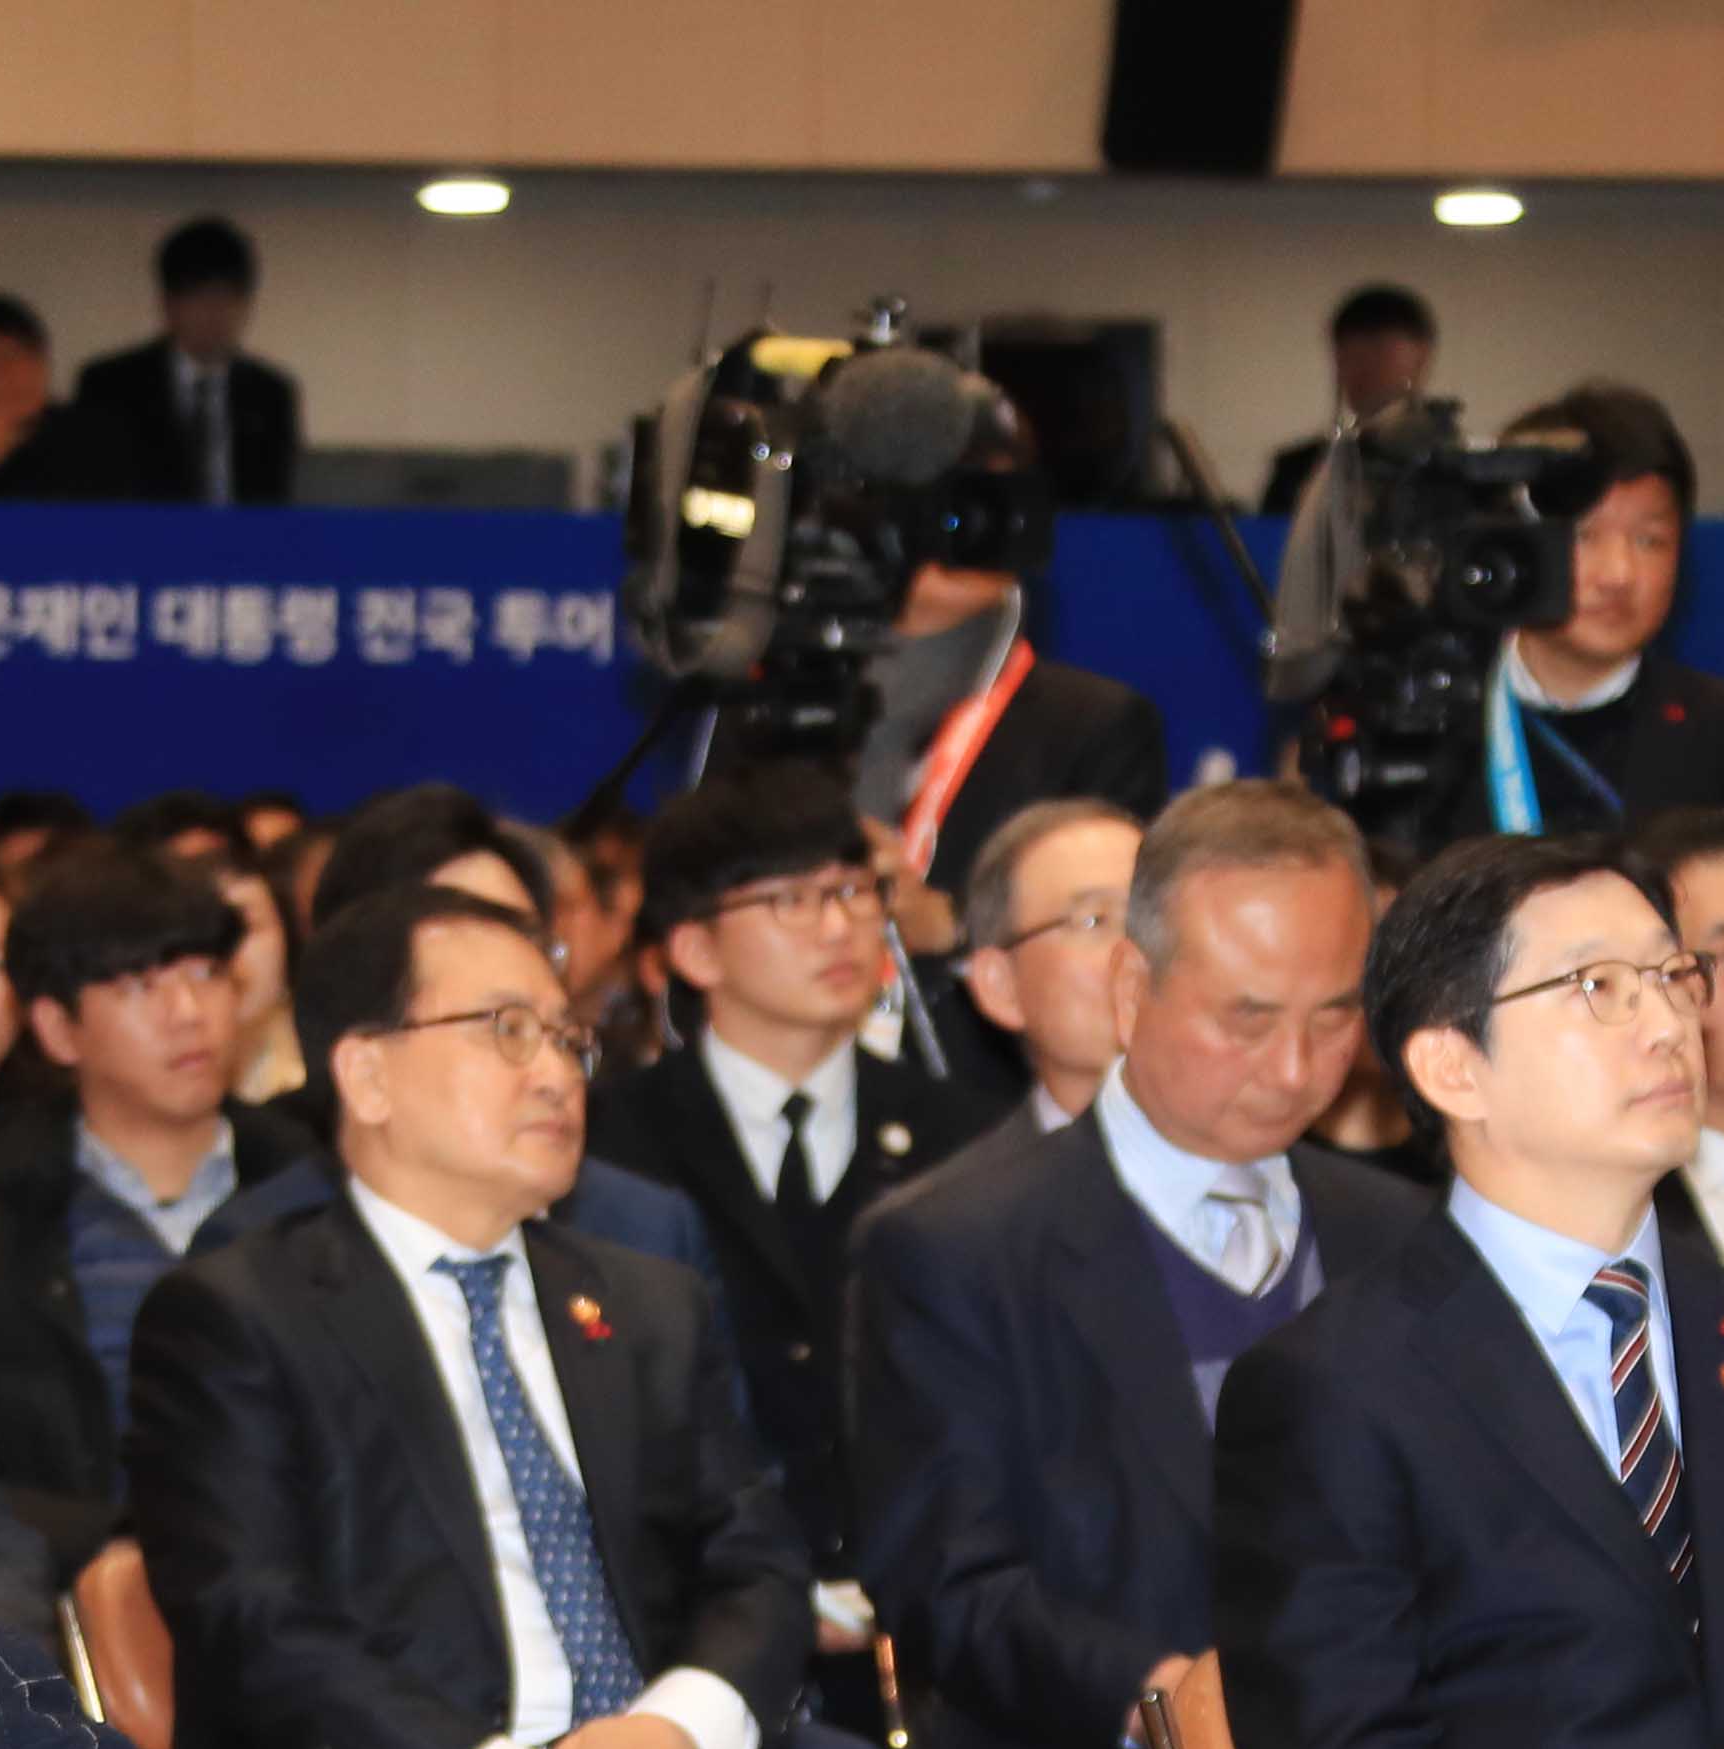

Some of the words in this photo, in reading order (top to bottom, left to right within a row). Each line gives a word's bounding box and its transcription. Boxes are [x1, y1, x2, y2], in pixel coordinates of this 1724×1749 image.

[153, 585, 338, 663] 대통령
[357, 588, 476, 662] 전국
[493, 589, 614, 664] 투어
